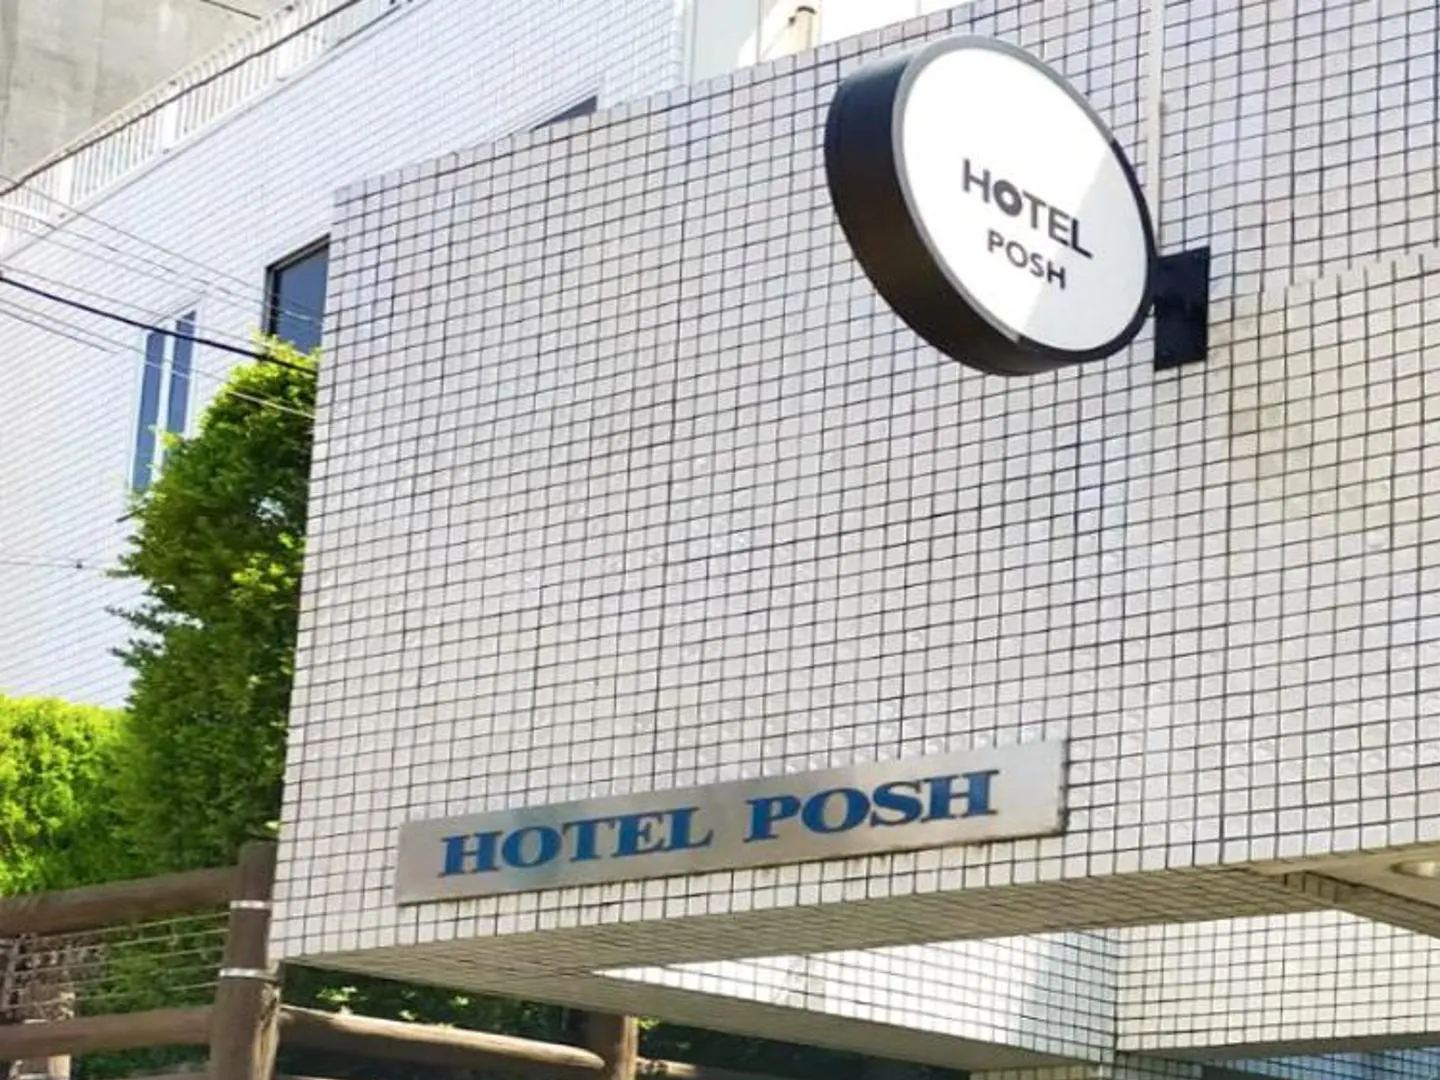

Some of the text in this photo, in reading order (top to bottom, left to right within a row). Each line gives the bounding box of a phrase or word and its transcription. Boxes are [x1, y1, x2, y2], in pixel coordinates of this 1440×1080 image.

[962, 157, 1094, 260] HOTEL
[986, 227, 1066, 291] POSH
[437, 768, 1000, 878] HOTEL POSH
